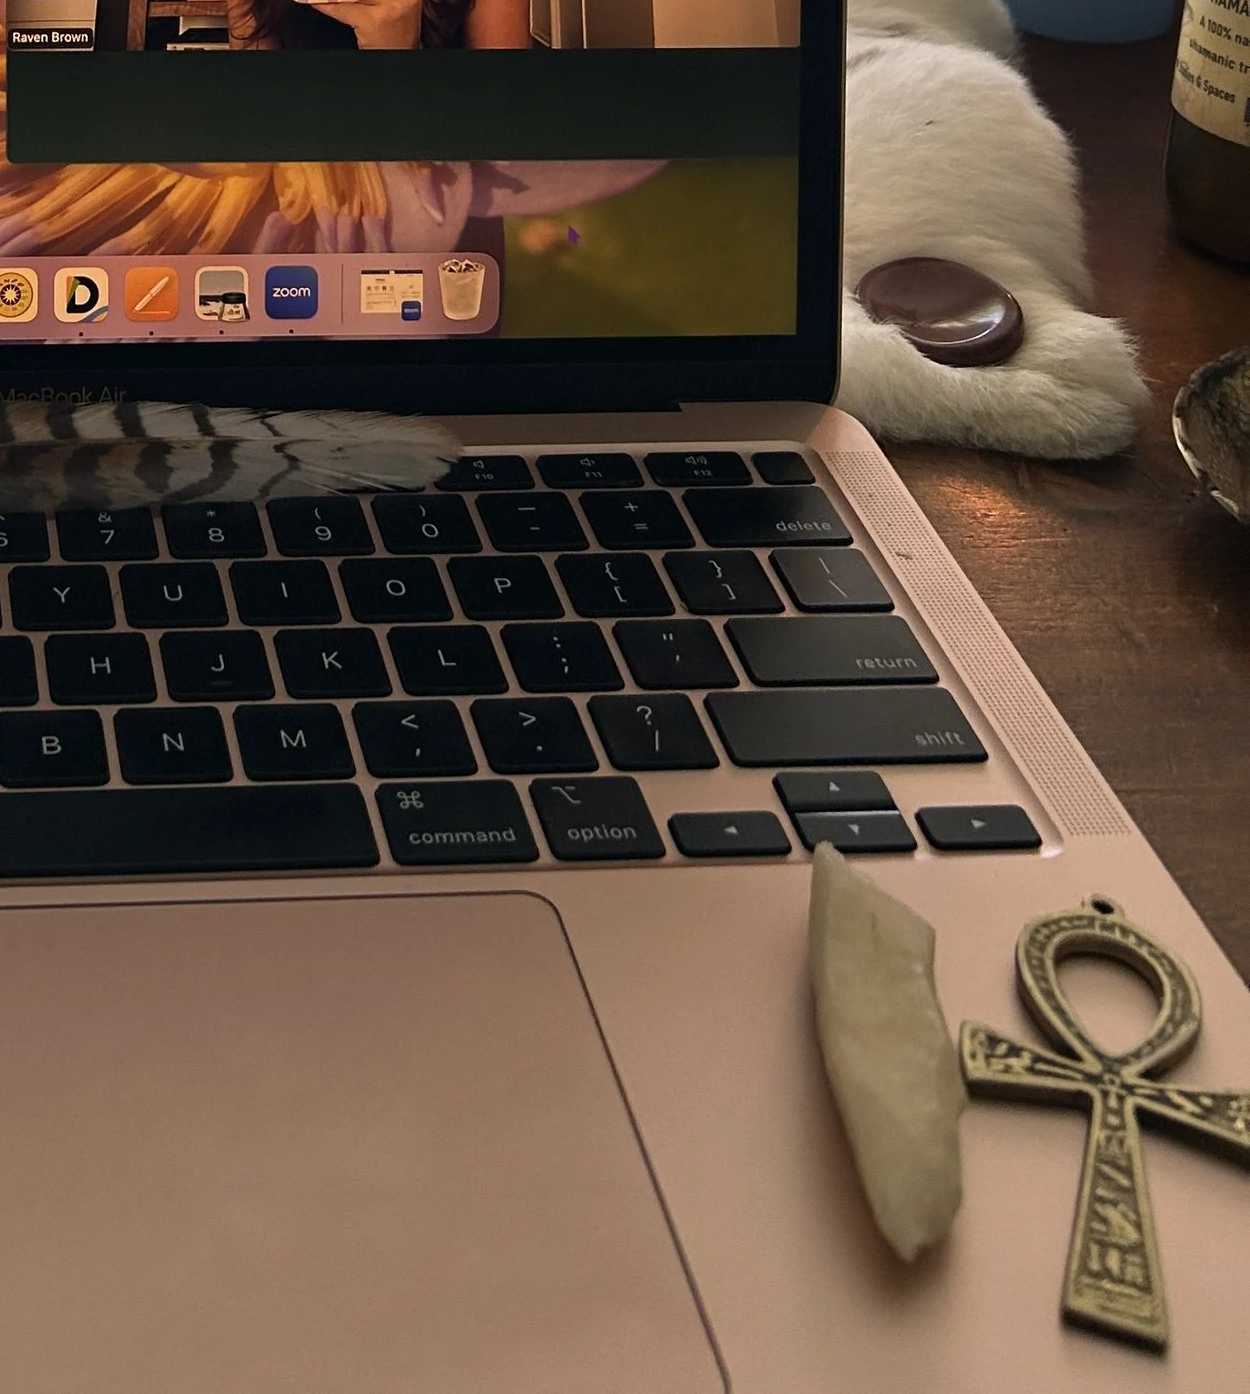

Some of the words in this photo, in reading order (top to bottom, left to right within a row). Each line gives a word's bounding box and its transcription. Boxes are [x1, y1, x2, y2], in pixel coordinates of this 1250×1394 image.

[1199, 16, 1205, 28] A
[1208, 19, 1232, 40] 100%
[12, 32, 48, 43] Raven
[51, 31, 89, 43] Brown
[1203, 79, 1236, 103] Spaces
[272, 287, 311, 298] zoom
[99, 386, 126, 403] Air
[693, 469, 713, 477] F12
[209, 527, 225, 542] 8
[315, 526, 332, 541] 9
[421, 523, 439, 538] 0
[776, 520, 832, 532] delete
[100, 529, 115, 544] 7
[163, 584, 183, 601] U
[281, 582, 288, 598] I
[386, 579, 406, 596] O
[493, 577, 512, 594] P
[52, 586, 71, 603] Y
[90, 657, 111, 674] H
[210, 654, 225, 672] J
[322, 652, 342, 669] K
[438, 649, 457, 666] L
[855, 656, 918, 669] return
[41, 736, 62, 755] B
[162, 733, 185, 752] N
[280, 730, 307, 748] M
[915, 732, 965, 746] shift
[409, 828, 516, 844] command
[567, 825, 637, 841] option
